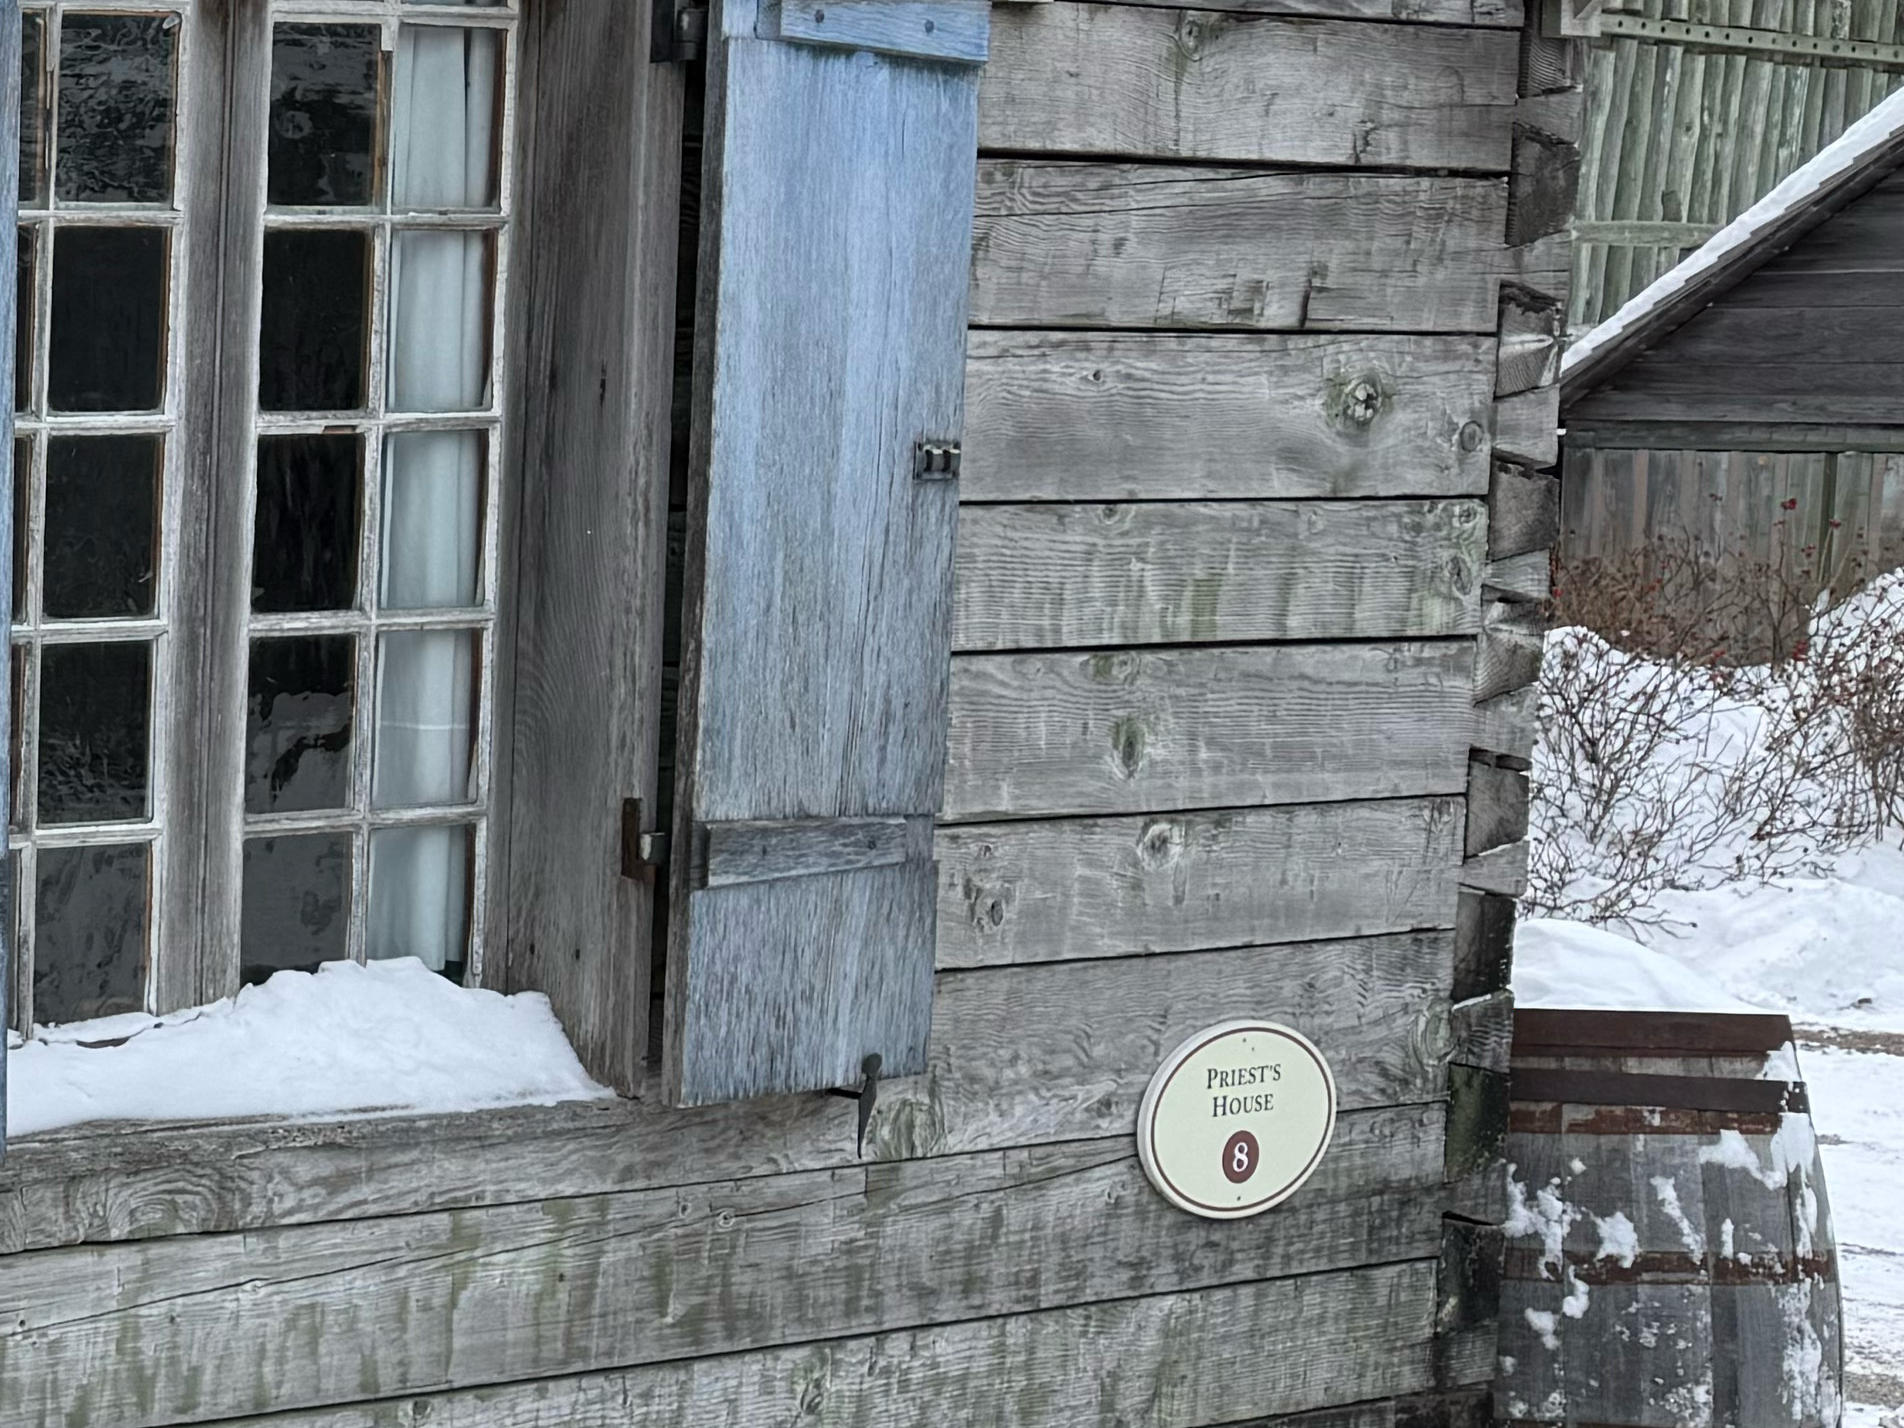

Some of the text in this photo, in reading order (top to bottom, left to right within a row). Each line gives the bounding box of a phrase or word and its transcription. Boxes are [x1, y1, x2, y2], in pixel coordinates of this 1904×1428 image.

[1206, 1063, 1282, 1090] PRIEST'S
[1211, 1093, 1274, 1118] HOUSE
[1232, 1141, 1249, 1173] 8
